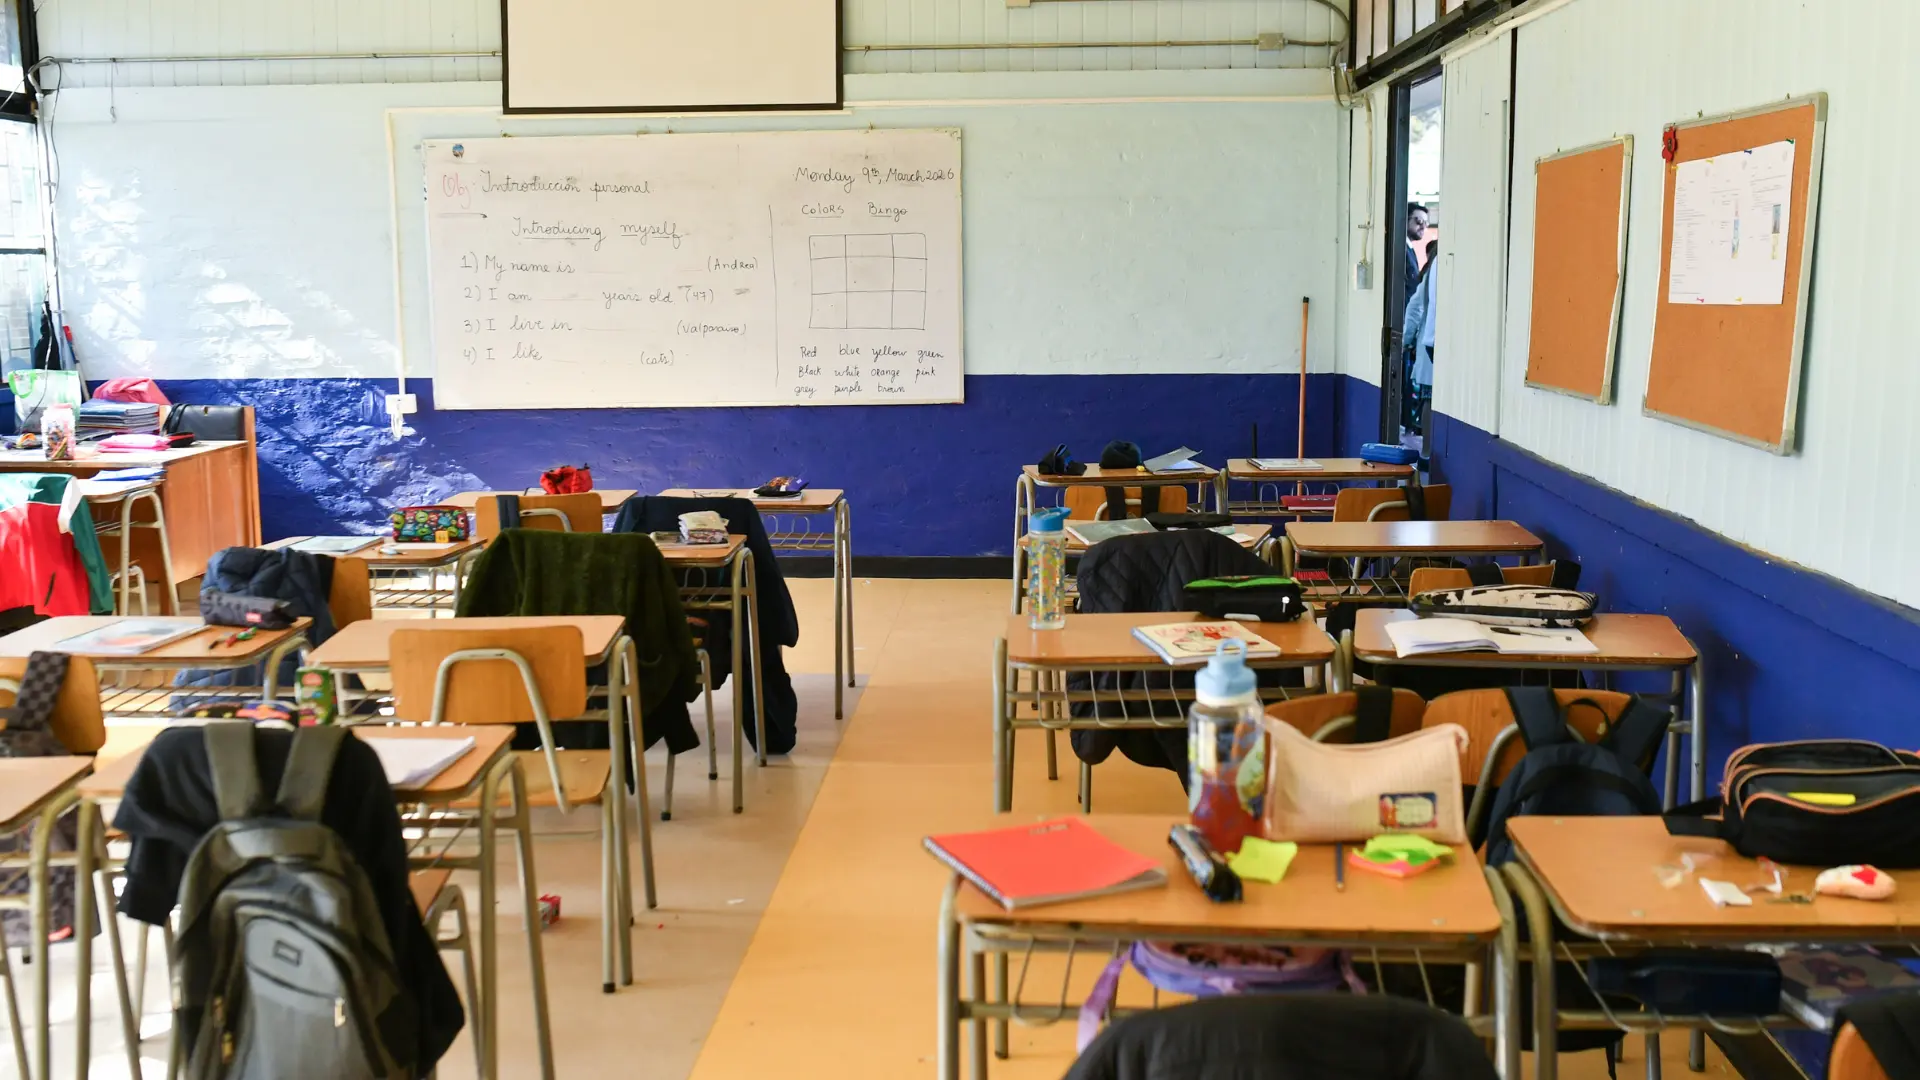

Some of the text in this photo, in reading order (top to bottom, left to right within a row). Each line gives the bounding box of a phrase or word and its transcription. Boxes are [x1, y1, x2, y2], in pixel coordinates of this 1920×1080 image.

[795, 166, 856, 194] Monday
[885, 167, 926, 183] March
[925, 167, 955, 181] 2026
[867, 201, 908, 223] Bingo
[511, 216, 684, 252] Introducing myself
[460, 251, 479, 274] 1)
[485, 254, 506, 282] My
[510, 261, 551, 274] name
[556, 261, 576, 274] is
[463, 285, 482, 302] 2)
[488, 287, 498, 301] I
[507, 292, 533, 302] am
[602, 290, 643, 310] years
[685, 288, 714, 305] (47)
[463, 318, 481, 335] 3)
[486, 318, 497, 332] I
[510, 314, 544, 331] live
[550, 320, 573, 332] in
[462, 341, 674, 367] 4) I like (cats)
[799, 343, 944, 364] Red blue yellow green
[798, 364, 822, 379] Black
[834, 364, 860, 378] white
[914, 365, 937, 384] pink
[794, 380, 906, 399] grey purple brown
